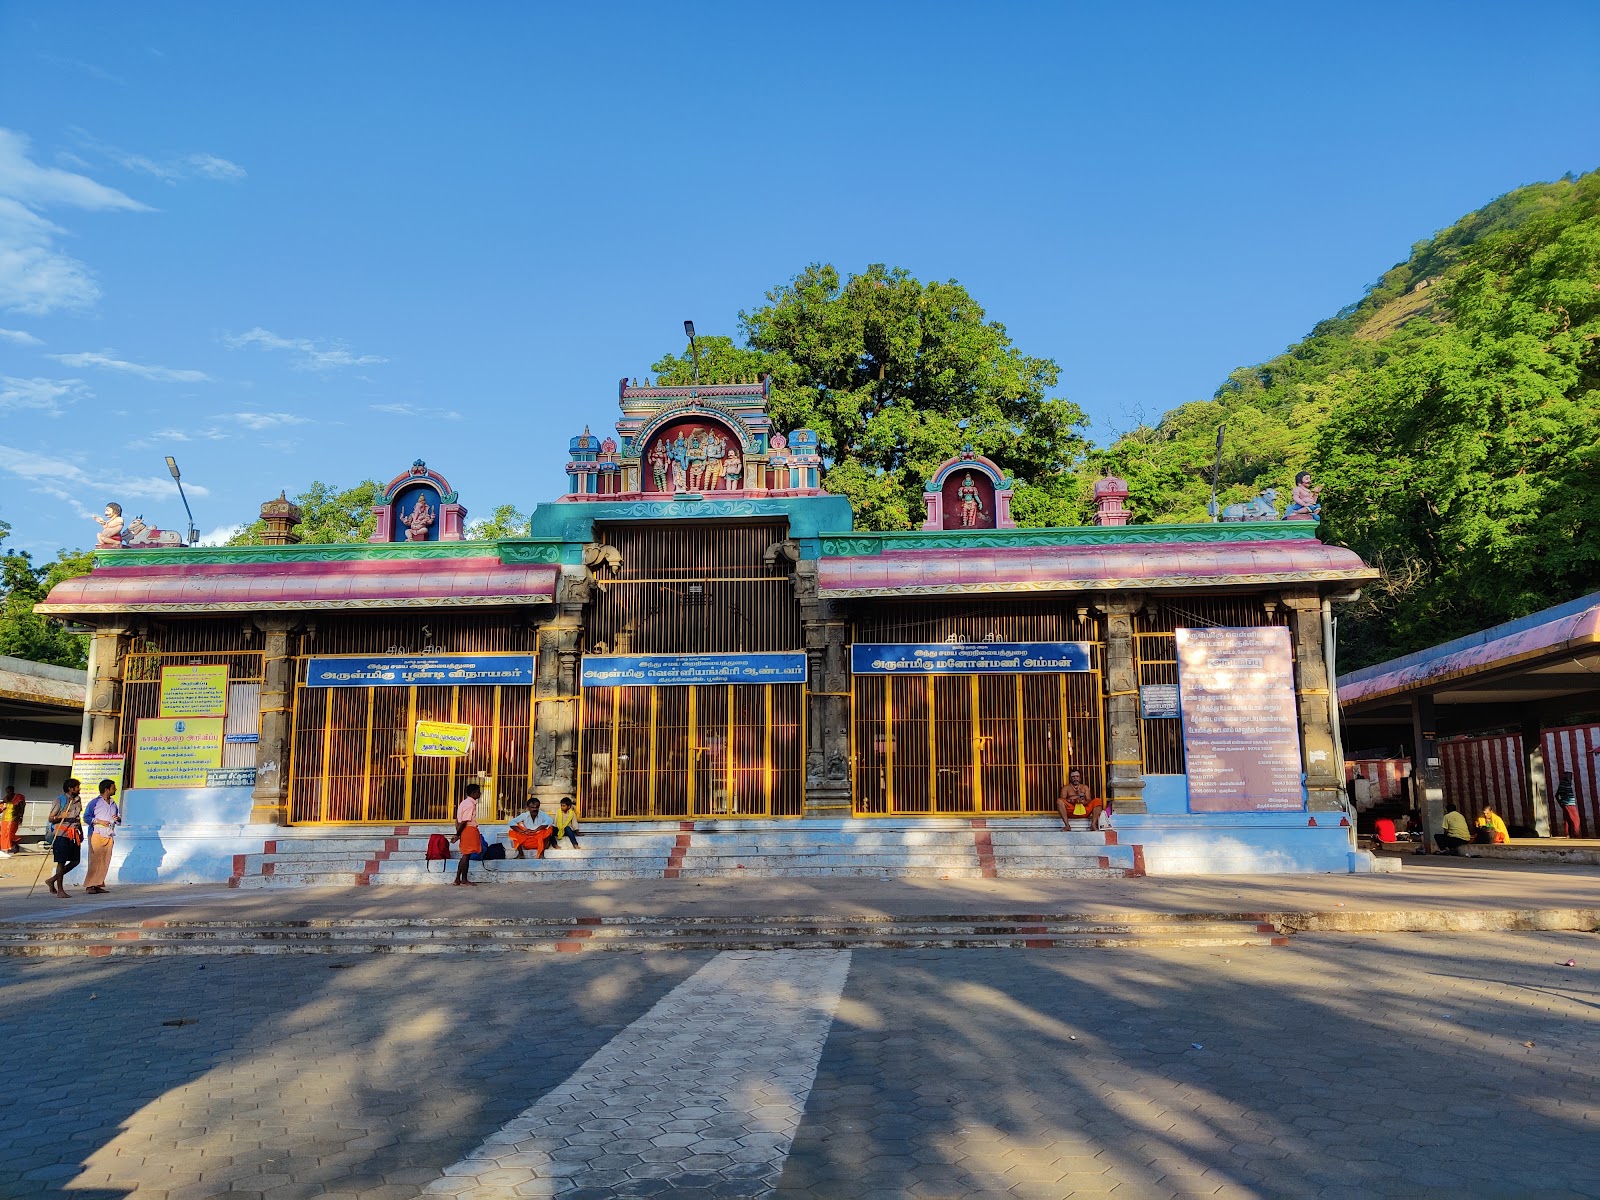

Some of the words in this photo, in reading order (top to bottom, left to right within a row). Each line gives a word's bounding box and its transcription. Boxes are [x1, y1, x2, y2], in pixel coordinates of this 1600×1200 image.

[871, 657, 934, 670] அருள்மிகு
[936, 657, 1020, 668] மனோன்மணி
[1023, 656, 1072, 667] அம்மன்
[1211, 659, 1261, 667] அறிவிப்பு
[320, 669, 395, 680] அருள்மிகு
[402, 668, 445, 682] பூண்டி
[449, 668, 522, 679] விநாயகர்
[584, 668, 645, 679] அருள்மிகு
[648, 666, 739, 677] வெள்ளியங்கிரி
[743, 665, 803, 676] ஆண்டவர்
[141, 734, 184, 743] காவல்துறை
[186, 733, 218, 742] அறிவிப்பு
